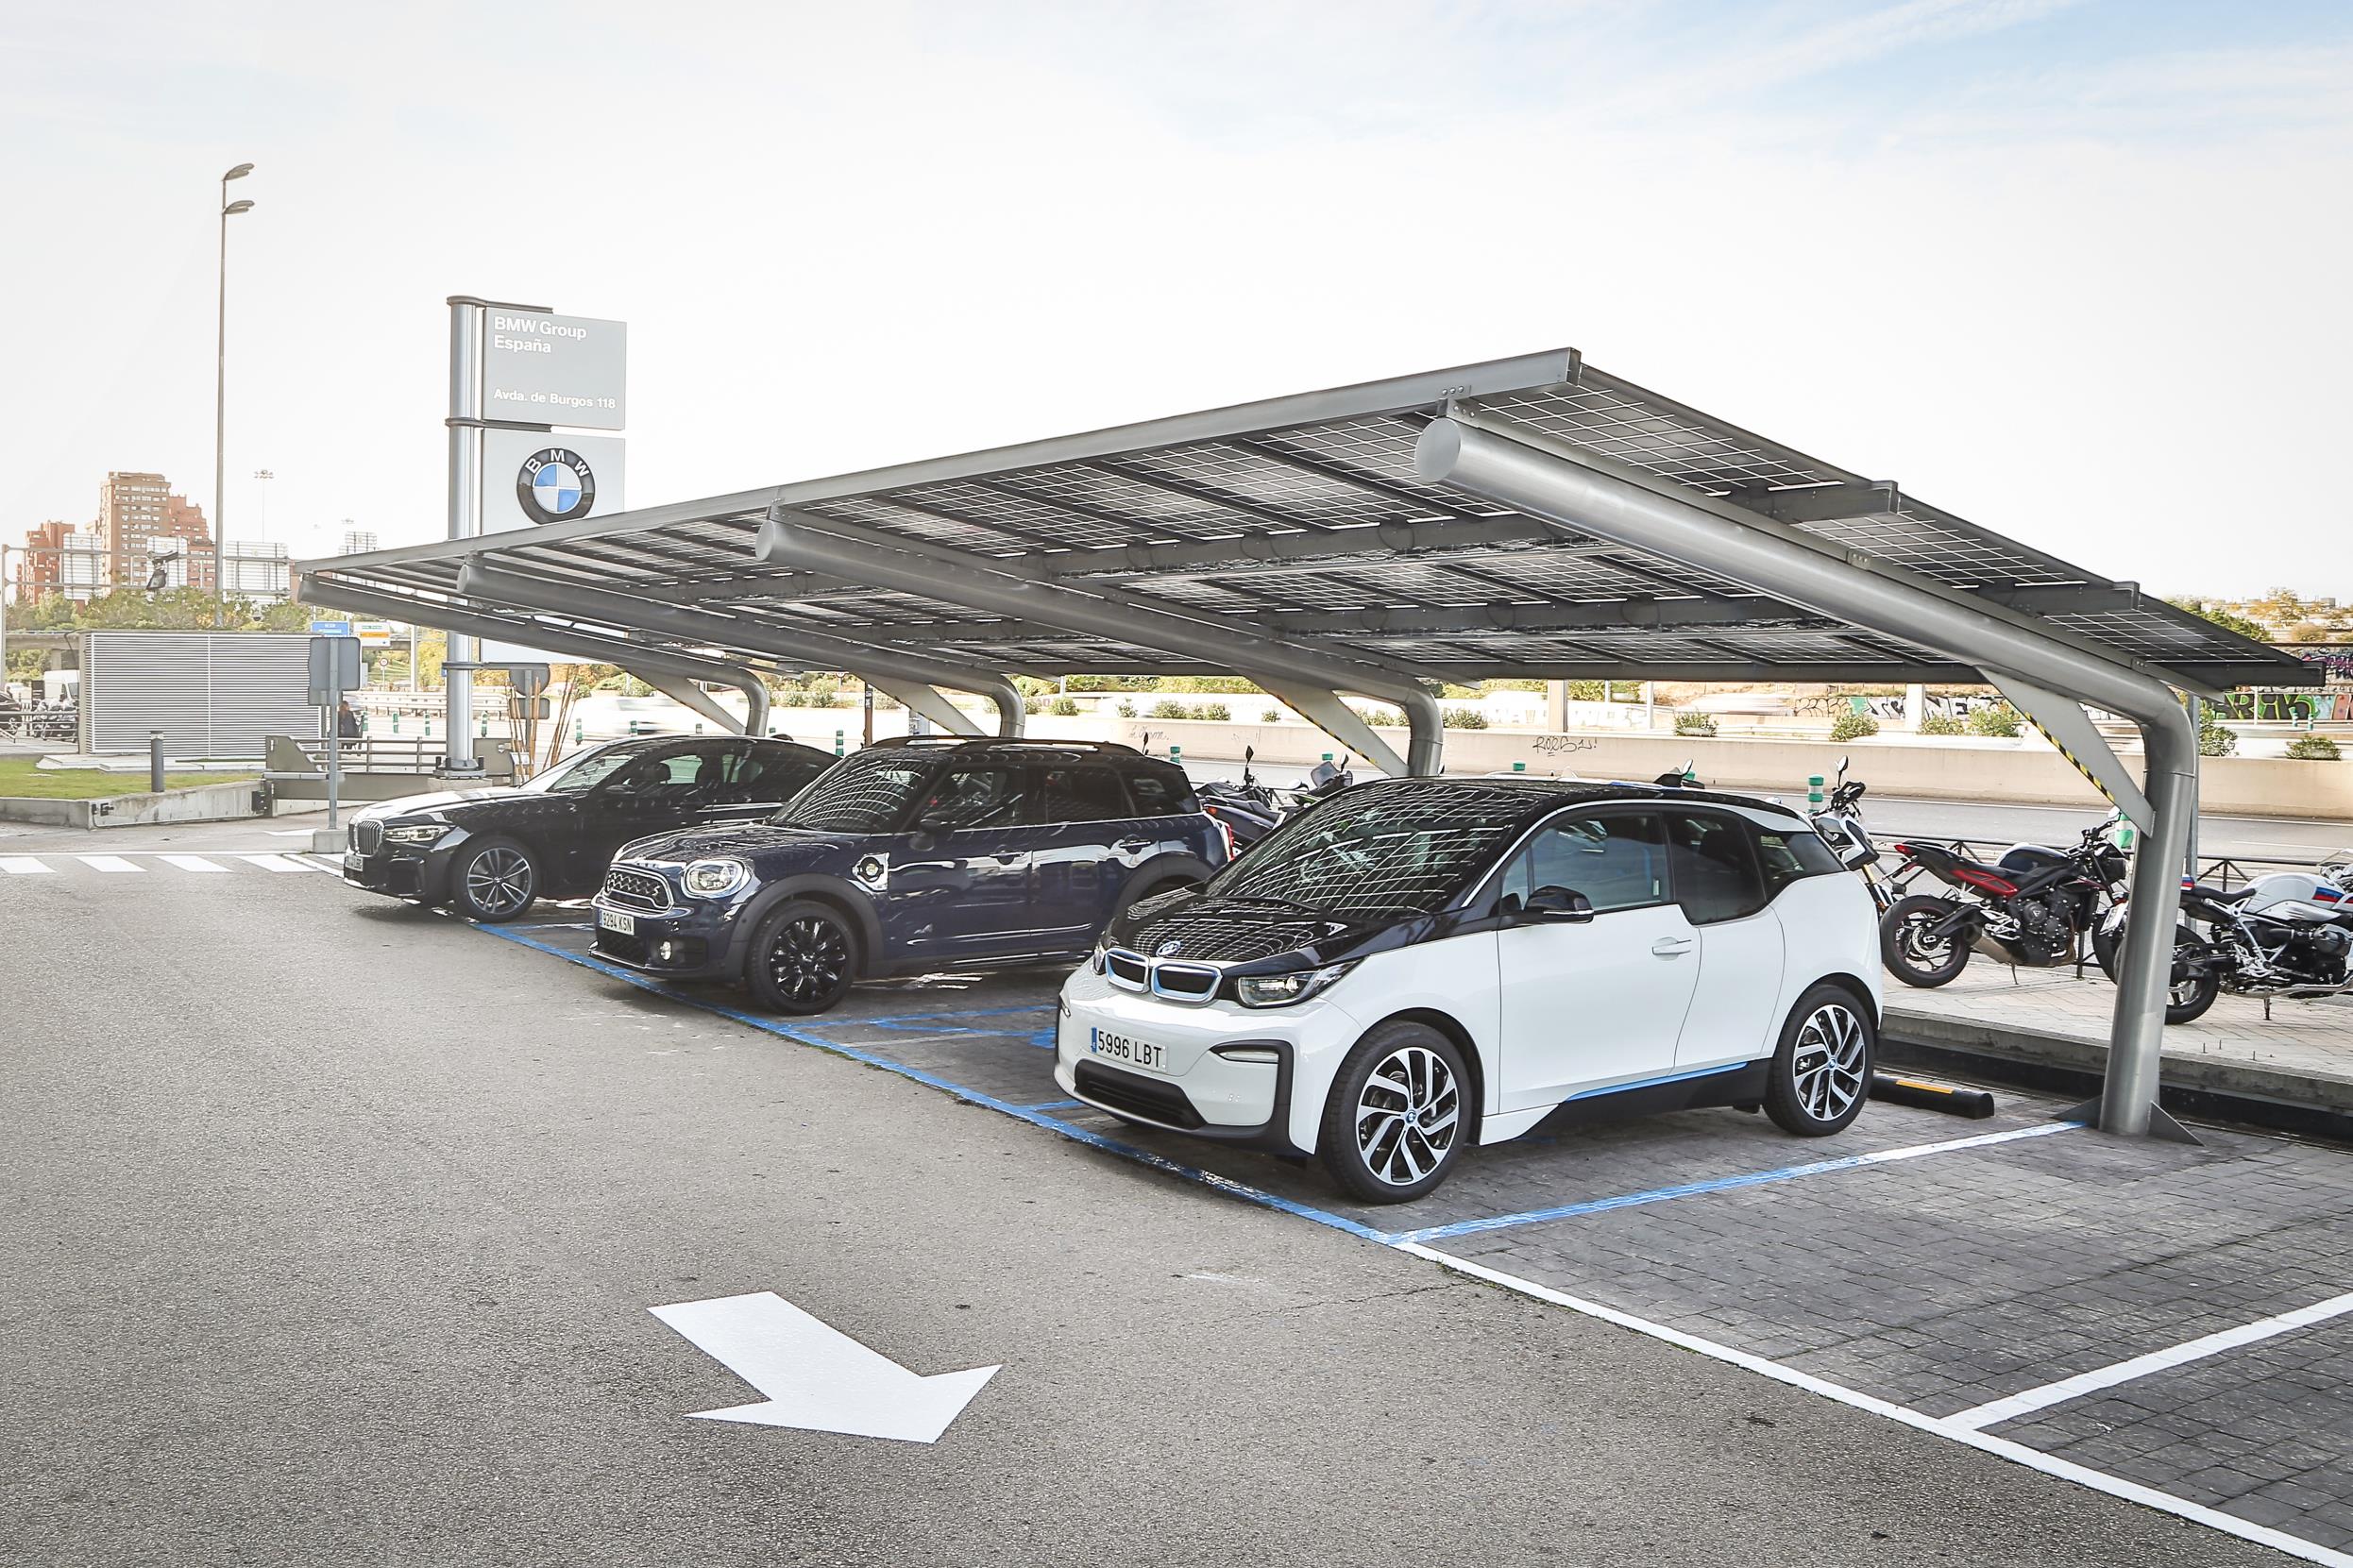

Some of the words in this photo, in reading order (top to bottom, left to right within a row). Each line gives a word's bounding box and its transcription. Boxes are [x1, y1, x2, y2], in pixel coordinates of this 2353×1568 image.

[494, 316, 536, 333] BMW
[539, 321, 587, 341] Group
[494, 334, 551, 353] España
[493, 388, 528, 401] Avda.
[530, 392, 546, 403] de
[550, 393, 593, 409] Burgos
[597, 397, 616, 409] 118
[525, 449, 589, 477] BMW
[1098, 1030, 1130, 1058] 5996
[1134, 1041, 1161, 1068] LBT
